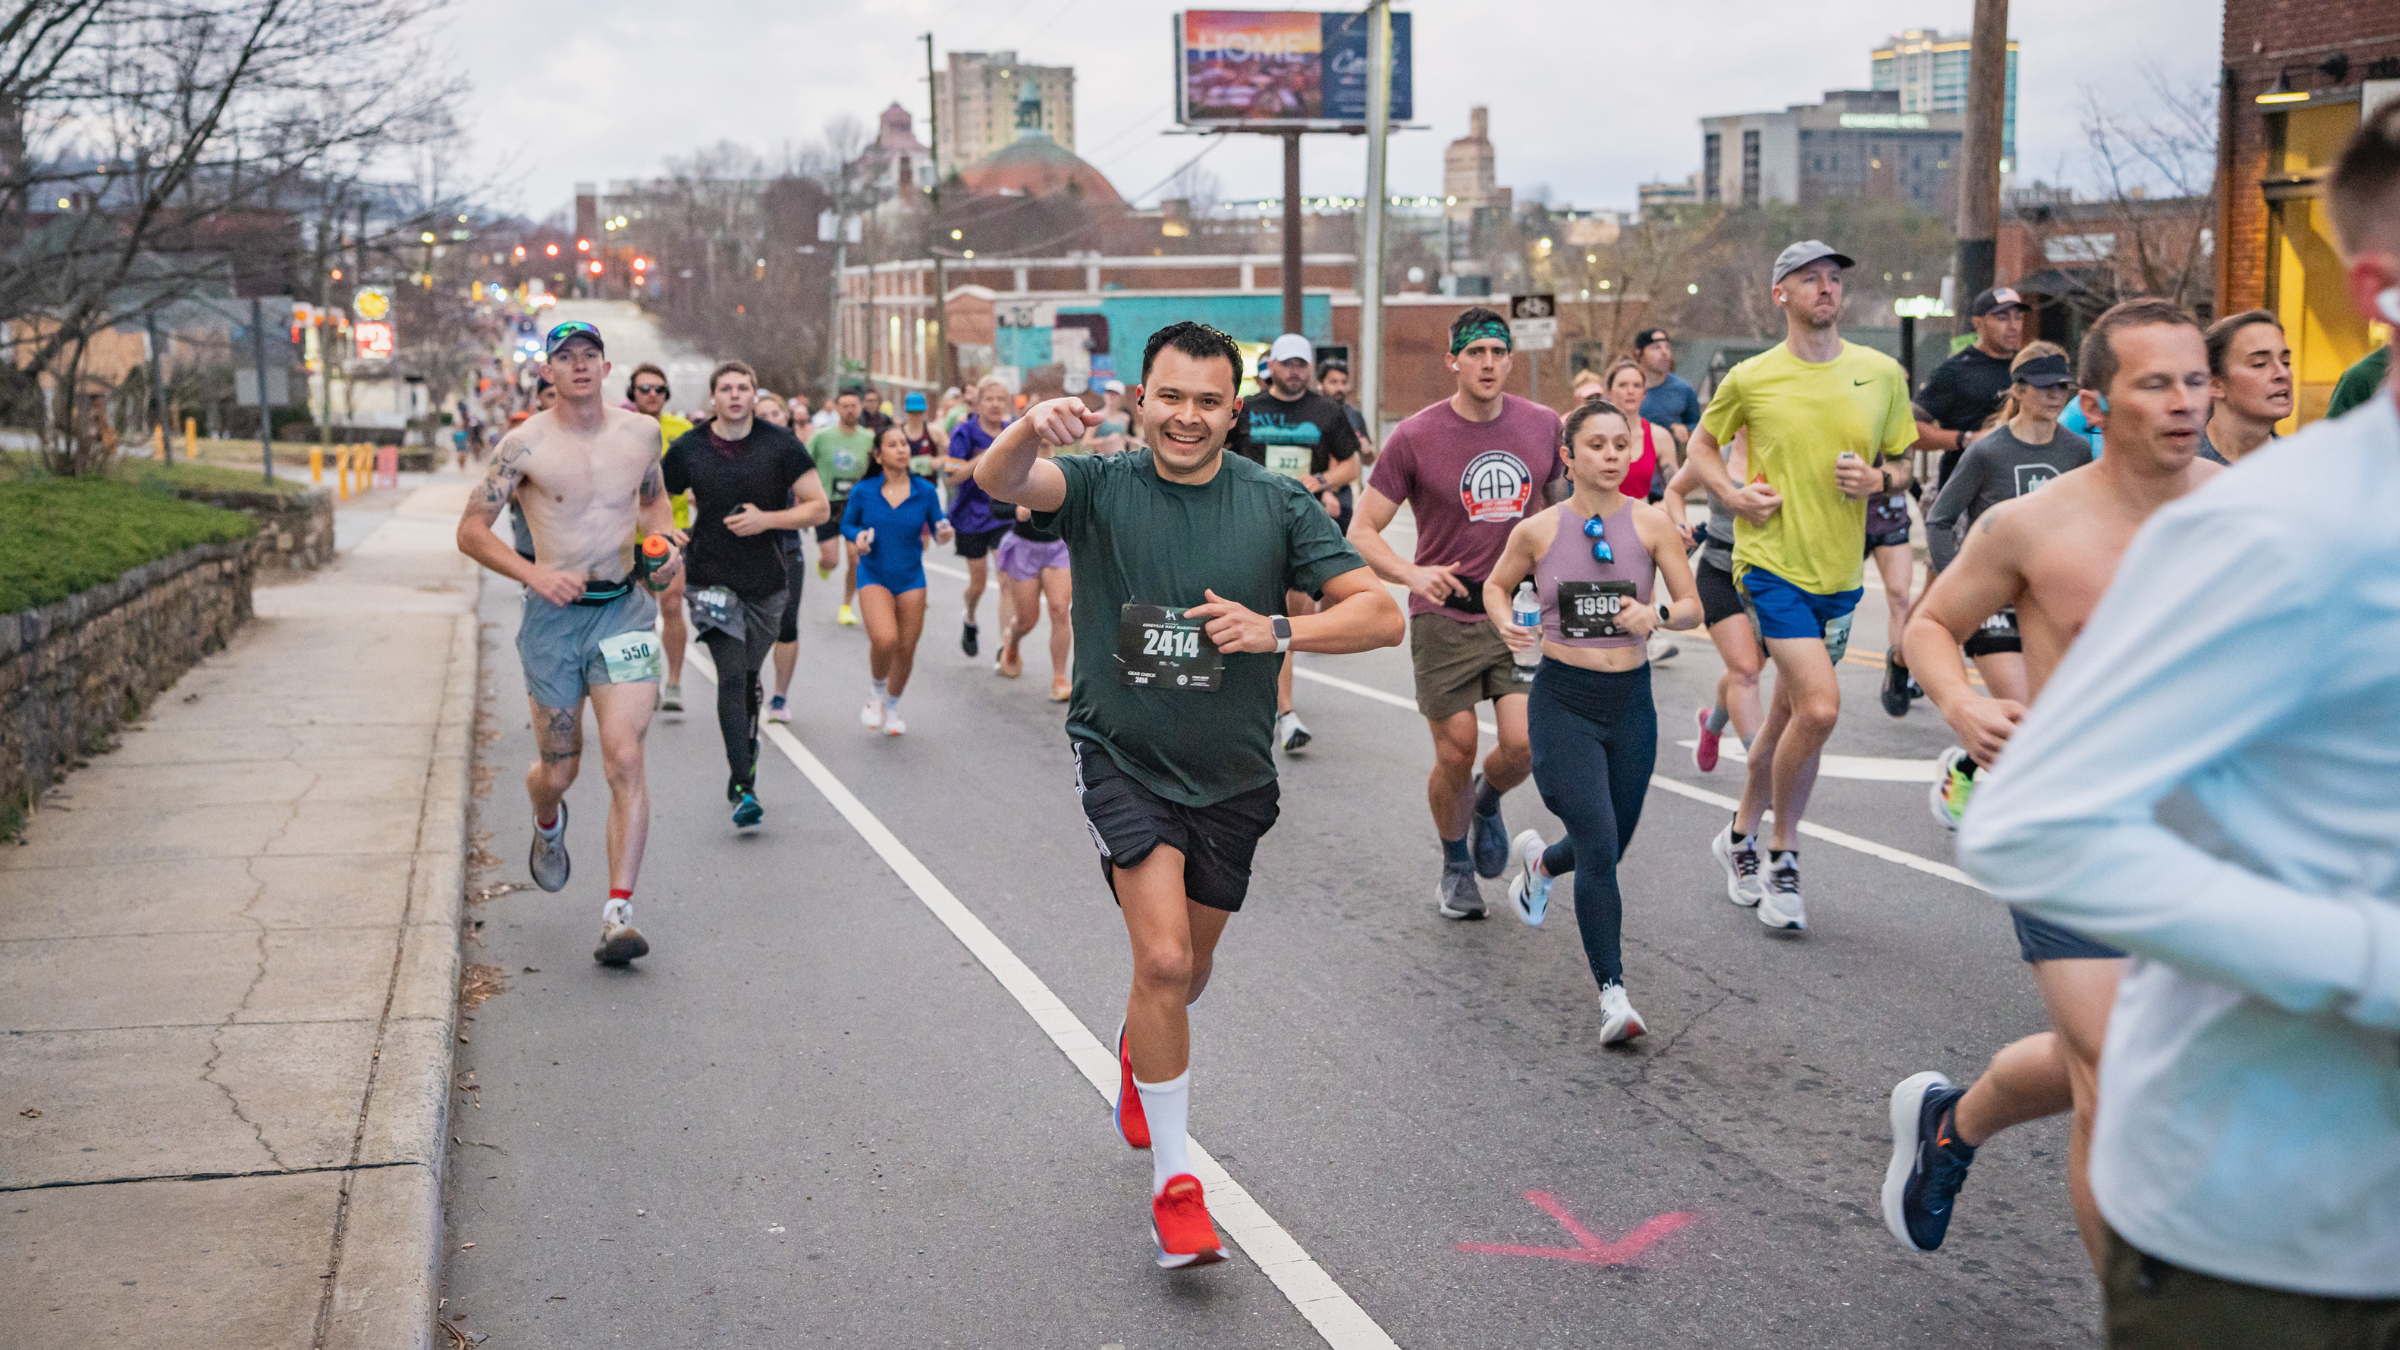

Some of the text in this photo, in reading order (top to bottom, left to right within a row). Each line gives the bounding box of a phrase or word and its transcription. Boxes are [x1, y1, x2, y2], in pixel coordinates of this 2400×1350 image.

[1199, 33, 1304, 62] HOME
[1479, 469, 1514, 499] AA
[1575, 596, 1620, 616] 1990
[621, 643, 650, 661] 550
[1143, 629, 1199, 658] 2414
